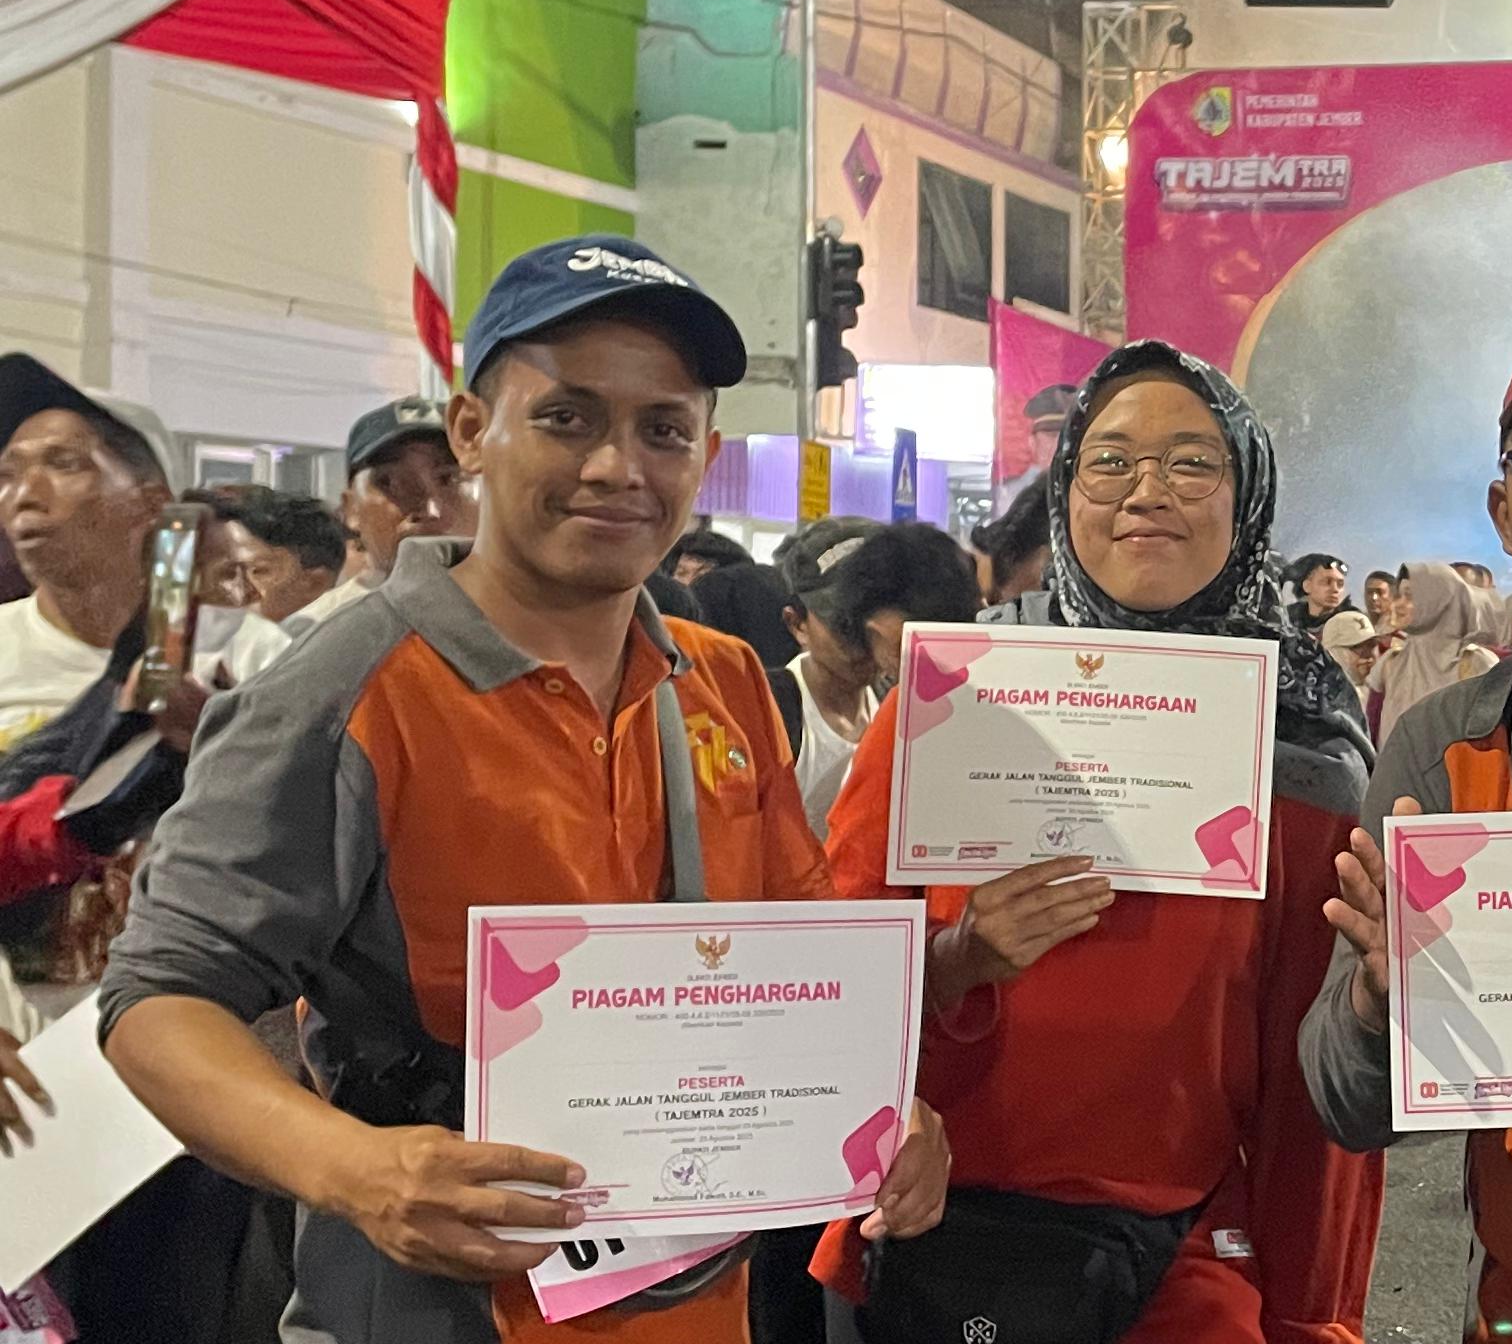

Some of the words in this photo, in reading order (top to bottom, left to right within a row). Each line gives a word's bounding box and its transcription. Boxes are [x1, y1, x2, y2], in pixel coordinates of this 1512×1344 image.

[976, 688, 1049, 707] PIAGAM
[1056, 689, 1197, 714] PENGHARGAAN
[1055, 762, 1110, 773] PESERTA
[1004, 772, 1035, 782] JALAN
[1087, 775, 1127, 786] JEMBER
[1094, 788, 1120, 798] 2025
[571, 987, 665, 1009] PIAGAM
[674, 981, 841, 1007] PENGHARGAAN
[678, 1075, 745, 1089] PESERTA
[568, 1097, 611, 1109] GERAK
[614, 1095, 653, 1107] JALAN
[656, 1092, 715, 1105] TANGGUL
[719, 1089, 766, 1102] JEMBER
[770, 1085, 841, 1098] TRADISIONAL
[663, 1108, 725, 1121] TAJEMTRA
[728, 1106, 759, 1118] 2025
